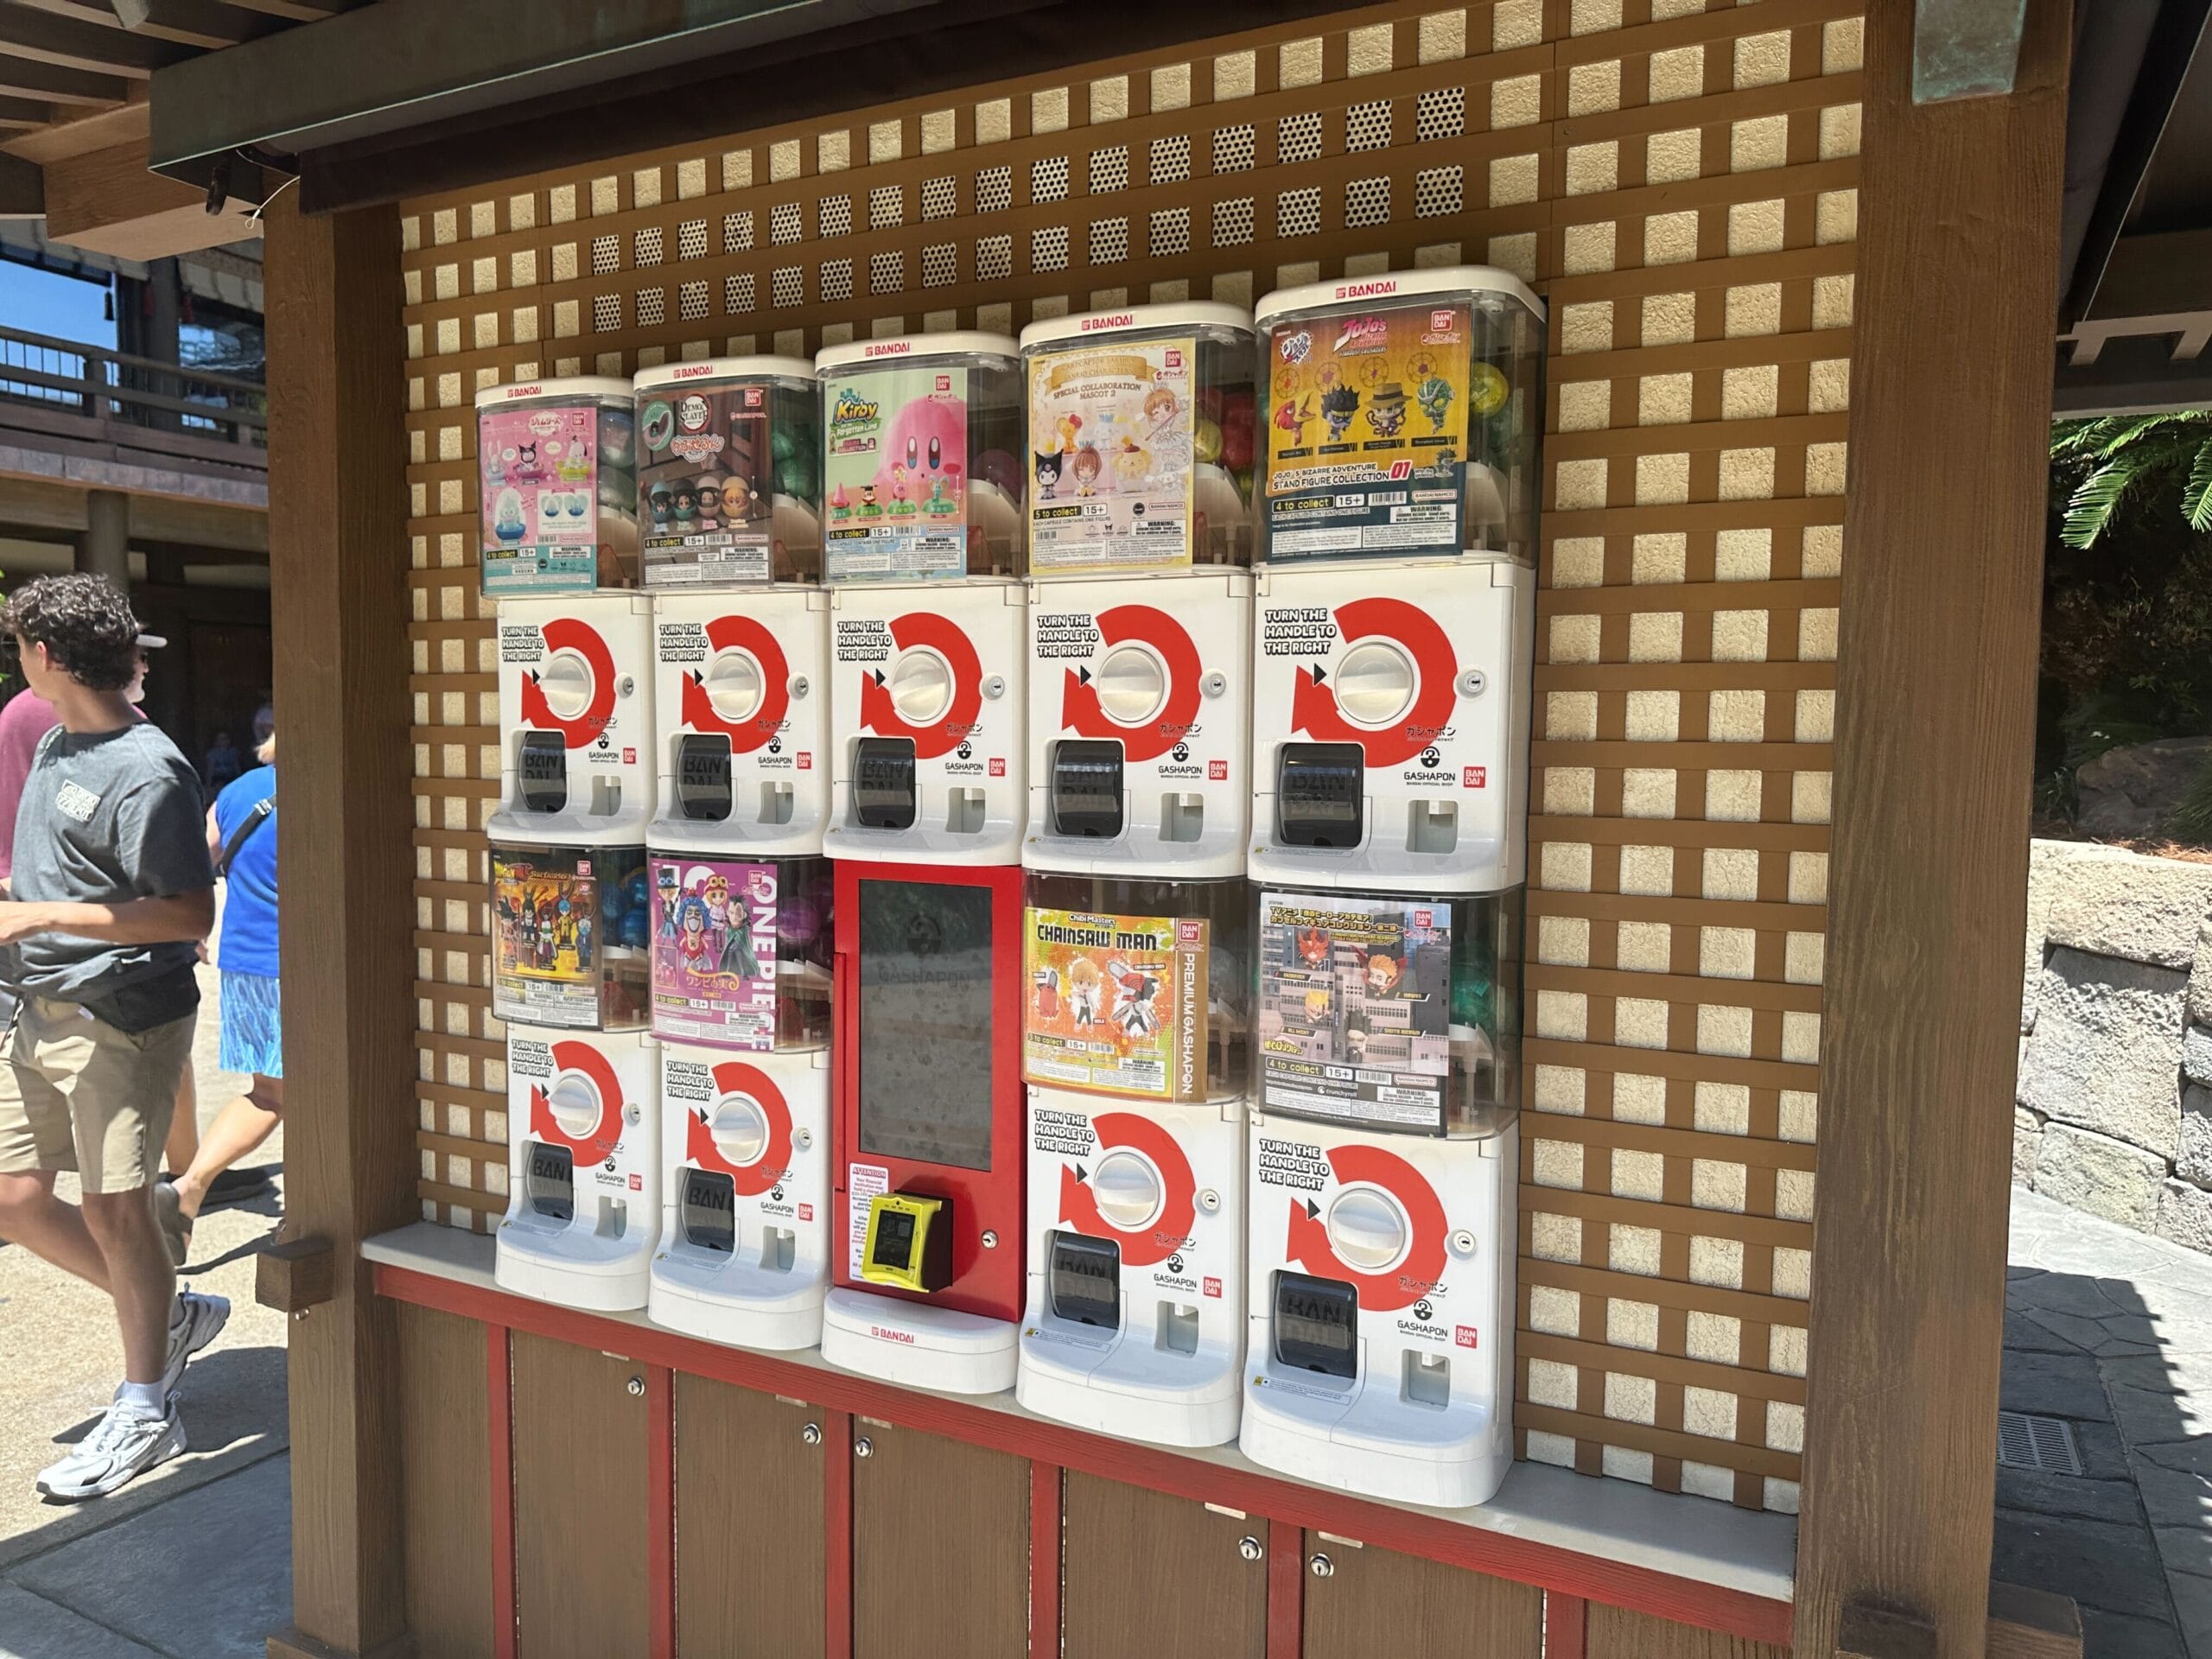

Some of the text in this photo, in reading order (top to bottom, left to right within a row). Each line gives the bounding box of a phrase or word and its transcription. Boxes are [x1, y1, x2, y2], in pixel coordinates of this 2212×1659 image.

[1349, 281, 1396, 296] BANDAI
[1092, 315, 1133, 329] BANDAI
[874, 343, 910, 355] BANDAI
[682, 365, 713, 378] BANDAI
[515, 386, 542, 397] BANDAI
[1053, 383, 1141, 399] SPECIAL COLLABORATION
[1080, 391, 1109, 400] MASCOT
[836, 399, 878, 423] Kirby
[1332, 463, 1376, 473] ADVENTURE
[1274, 461, 1411, 490] STAND FIGURE COLLECTION 01
[1084, 505, 1104, 514] 15+
[1296, 499, 1329, 509] collect
[1042, 509, 1050, 518] to
[1052, 507, 1077, 516] collect
[873, 528, 889, 537] 15+
[659, 537, 681, 546] collect
[1037, 614, 1090, 627] TURN THE
[1265, 608, 1327, 623] TURN THE
[502, 626, 538, 637] TURN THE
[659, 624, 702, 635] TURN THE
[837, 620, 885, 632] TURN THE
[1264, 625, 1337, 639] HANDLE TO
[838, 634, 892, 647] HANDLE TO
[1037, 629, 1099, 643] HANDLE TO
[502, 639, 544, 649] HANDLE TO
[660, 637, 709, 648] HANDLE TO
[1264, 641, 1331, 655] THE RIGHT
[503, 651, 542, 662] THE RIGHT
[660, 651, 705, 662] THE RIGHT
[838, 649, 888, 661] THE RIGHT
[1038, 645, 1094, 658] THE RIGHT
[1160, 723, 1202, 734] ガシャポン
[1406, 726, 1456, 737] ガシャポン
[1159, 766, 1203, 775] GASHAPON
[1465, 770, 1484, 779] BAN
[1404, 772, 1456, 783] GASHAPON
[1465, 777, 1480, 786] DAI
[752, 875, 777, 953] ONE
[1086, 916, 1116, 925] Masters
[1037, 925, 1157, 950] CHAINSAW MAN
[667, 997, 686, 1006] collect
[1182, 953, 1195, 1094] PREMIUM GASHAPON
[512, 1039, 549, 1053] TURN THE
[1044, 1037, 1063, 1047] collect
[512, 1052, 554, 1066] HANDLE TO
[512, 1064, 551, 1077] THE RIGHT
[667, 1060, 708, 1076] TURN THE
[1290, 1064, 1319, 1075] collect
[1329, 1068, 1349, 1078] 15+
[667, 1073, 715, 1090] HANDLE TO
[667, 1087, 711, 1102] THE RIGHT
[1326, 1089, 1357, 1097] crunchyroll
[1035, 1109, 1087, 1128] TURN THE
[1035, 1124, 1095, 1143] HANDLE TO
[1035, 1138, 1090, 1156] THE RIGHT
[1259, 1139, 1320, 1160] TURN THE
[1259, 1154, 1330, 1177] HANDLE TO
[595, 1172, 626, 1184] GASHAPON
[1259, 1169, 1325, 1192] THE RIGHT
[688, 1186, 726, 1211] BAN
[760, 1201, 794, 1214] GASHAPON
[1154, 1273, 1198, 1288] GASHAPON
[1205, 1279, 1221, 1289] BAN
[1205, 1286, 1217, 1296] DAI
[1397, 1320, 1448, 1338] GASHAPON
[1457, 1327, 1477, 1338] BAN
[880, 1328, 914, 1344] BANDAI
[1457, 1334, 1472, 1345] DAI
